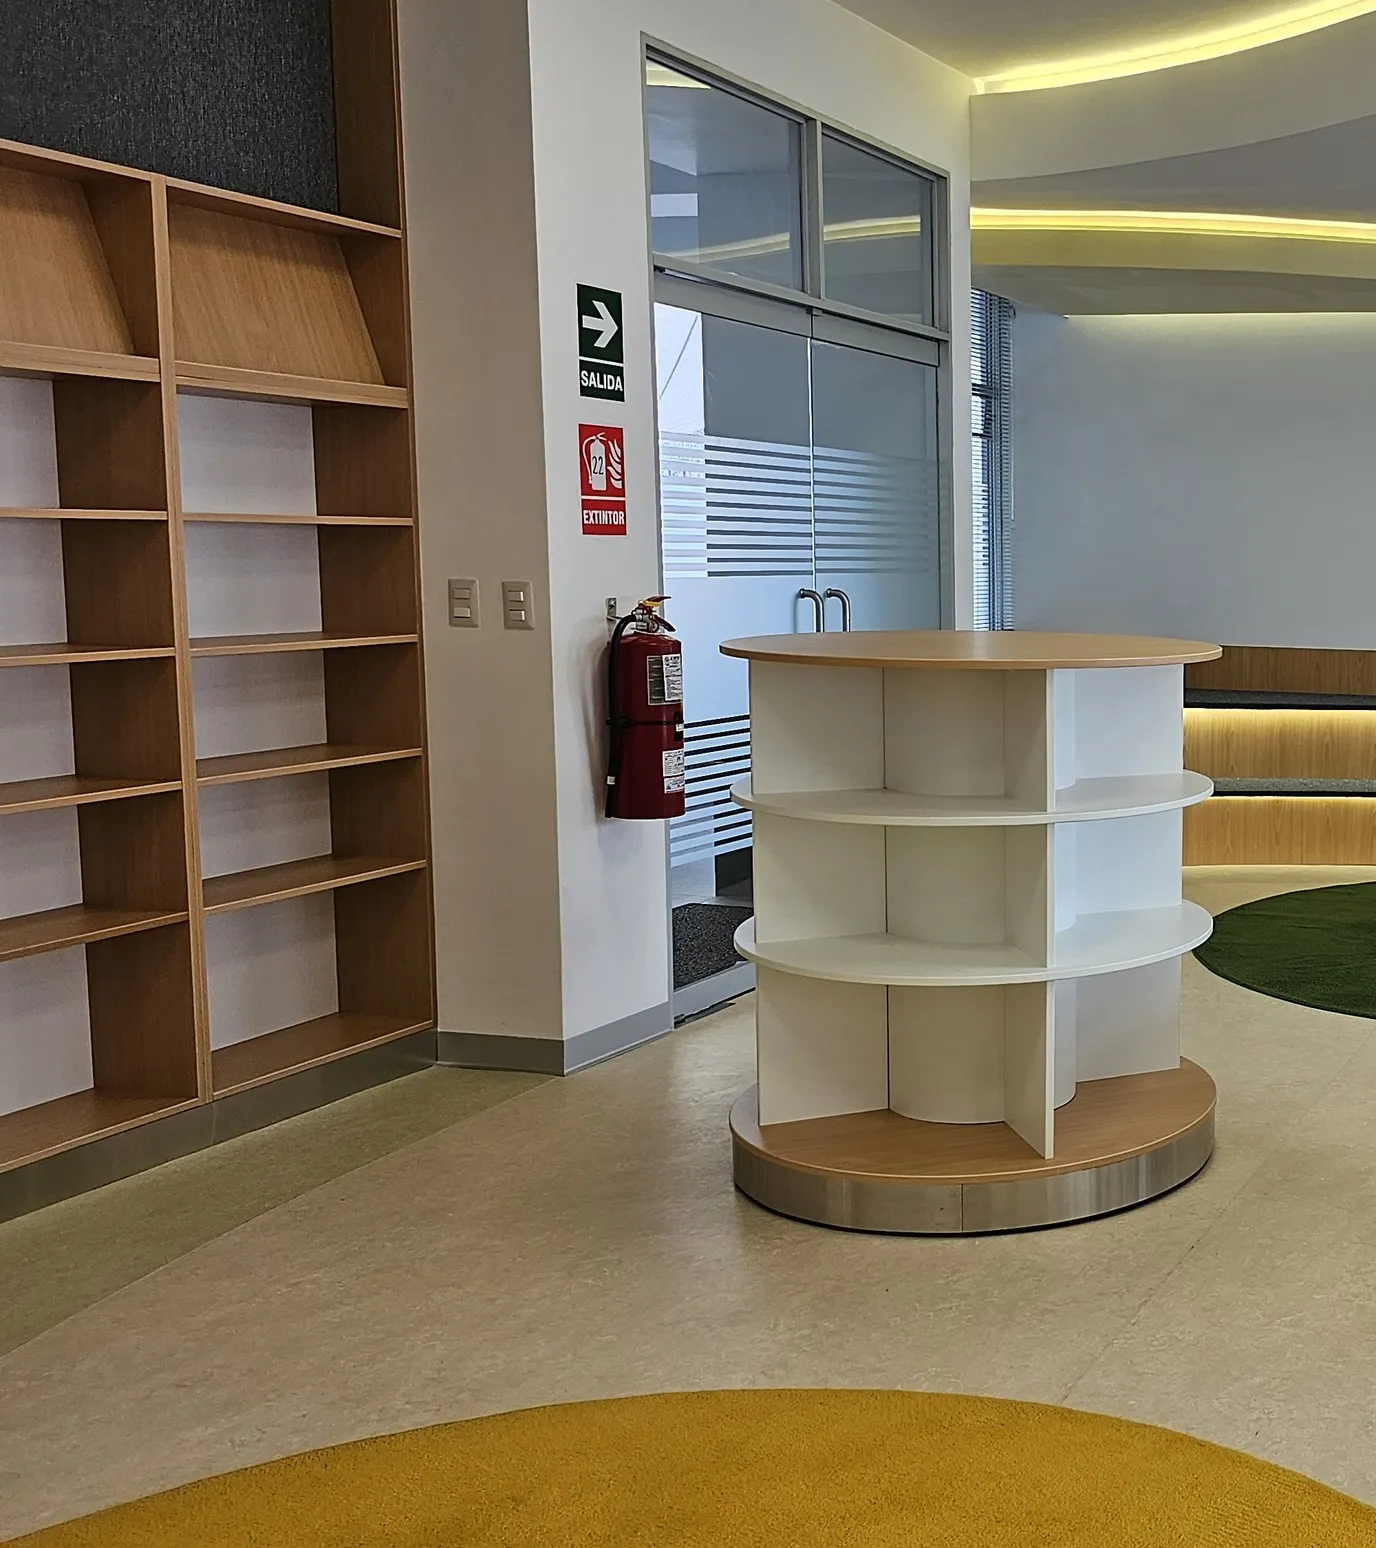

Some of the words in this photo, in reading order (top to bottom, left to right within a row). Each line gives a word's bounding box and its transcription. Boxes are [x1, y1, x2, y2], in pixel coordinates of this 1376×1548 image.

[581, 370, 623, 392] SALIDA
[592, 455, 604, 475] 22
[583, 510, 625, 525] EXTINTOR
